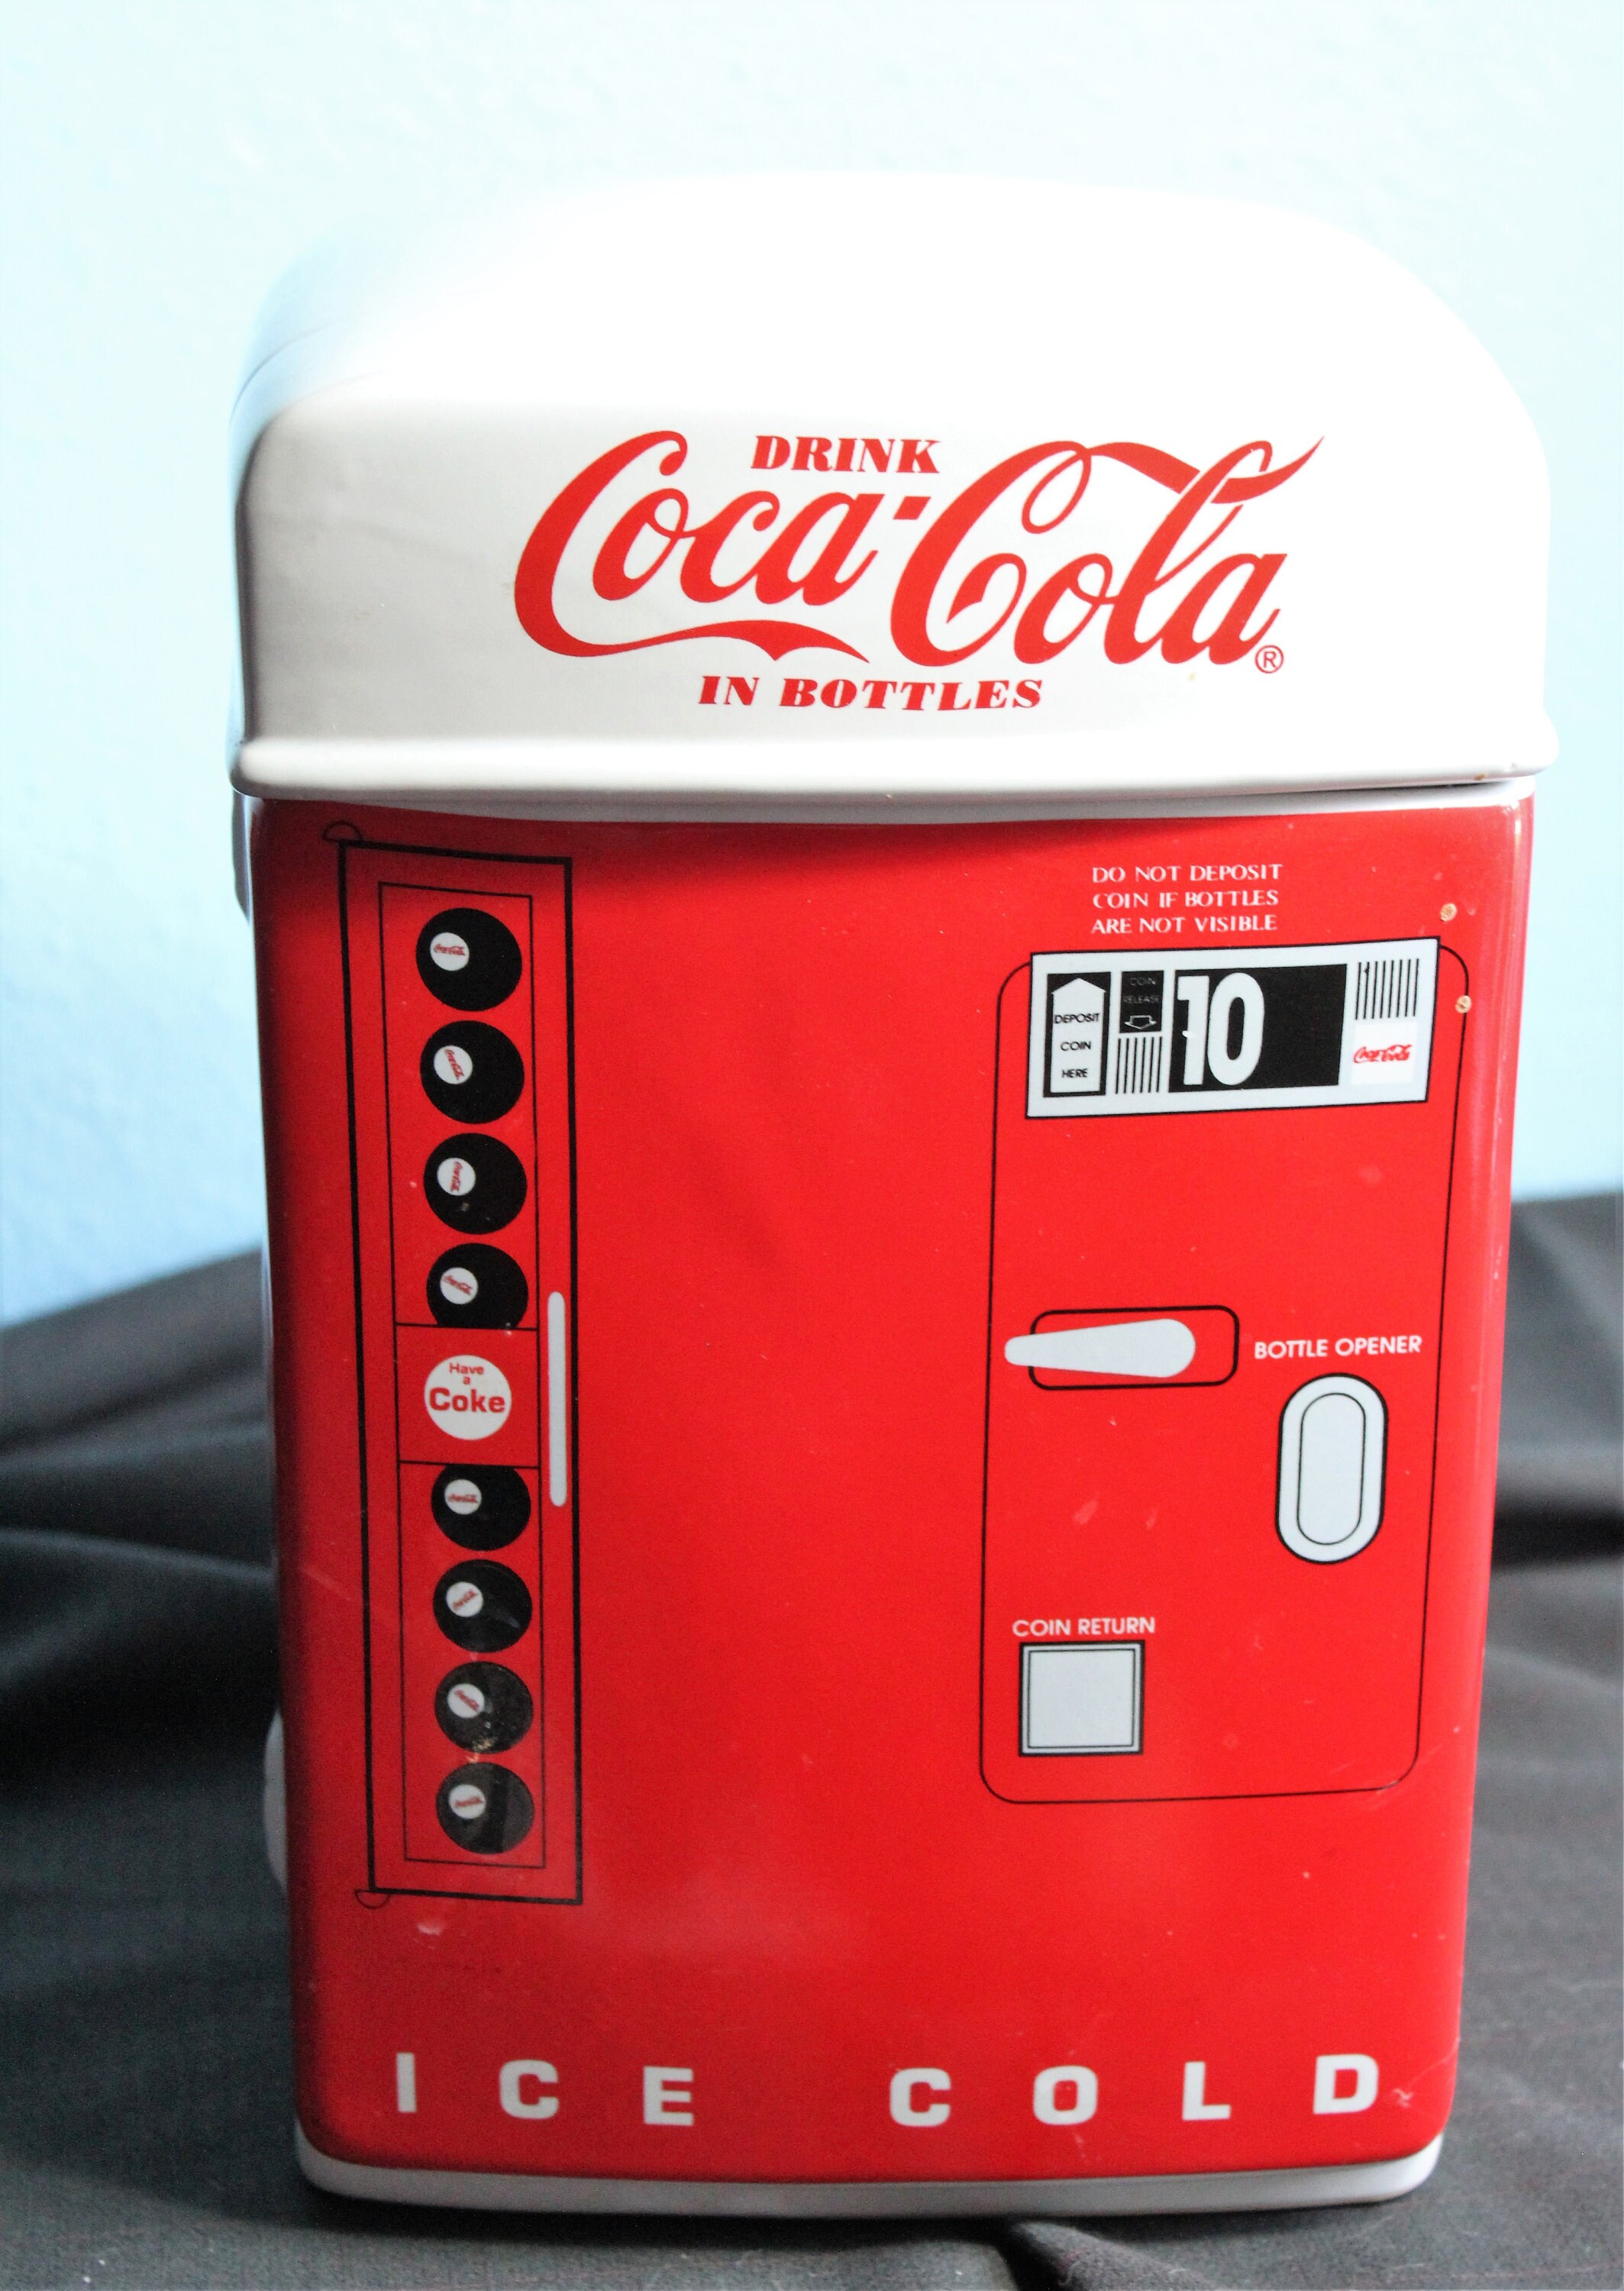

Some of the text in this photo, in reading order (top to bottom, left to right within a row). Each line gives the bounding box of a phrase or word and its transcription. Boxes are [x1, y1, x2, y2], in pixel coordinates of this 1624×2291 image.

[752, 435, 939, 473] DRINK
[514, 430, 1324, 667] Coca-Cola
[699, 675, 1042, 711] IN BOTTLES
[1092, 863, 1283, 884] DO NOT DEPOSIT
[1093, 889, 1279, 909] COIN IF BOTTLES
[1091, 914, 1277, 935] ARE NOT VISIBLE
[1054, 1013, 1099, 1024] DEPOSIT
[1177, 972, 1265, 1086] 10
[1061, 1041, 1092, 1052] COIN
[1062, 1068, 1088, 1078] HERE
[1254, 1334, 1422, 1359] BOTTLE OPENER
[449, 1362, 485, 1375] Have
[463, 1376, 471, 1385] a
[429, 1387, 506, 1414] Coke
[1012, 1616, 1156, 1637] COIN RETURN
[397, 2052, 1380, 2127] ICE COLD
